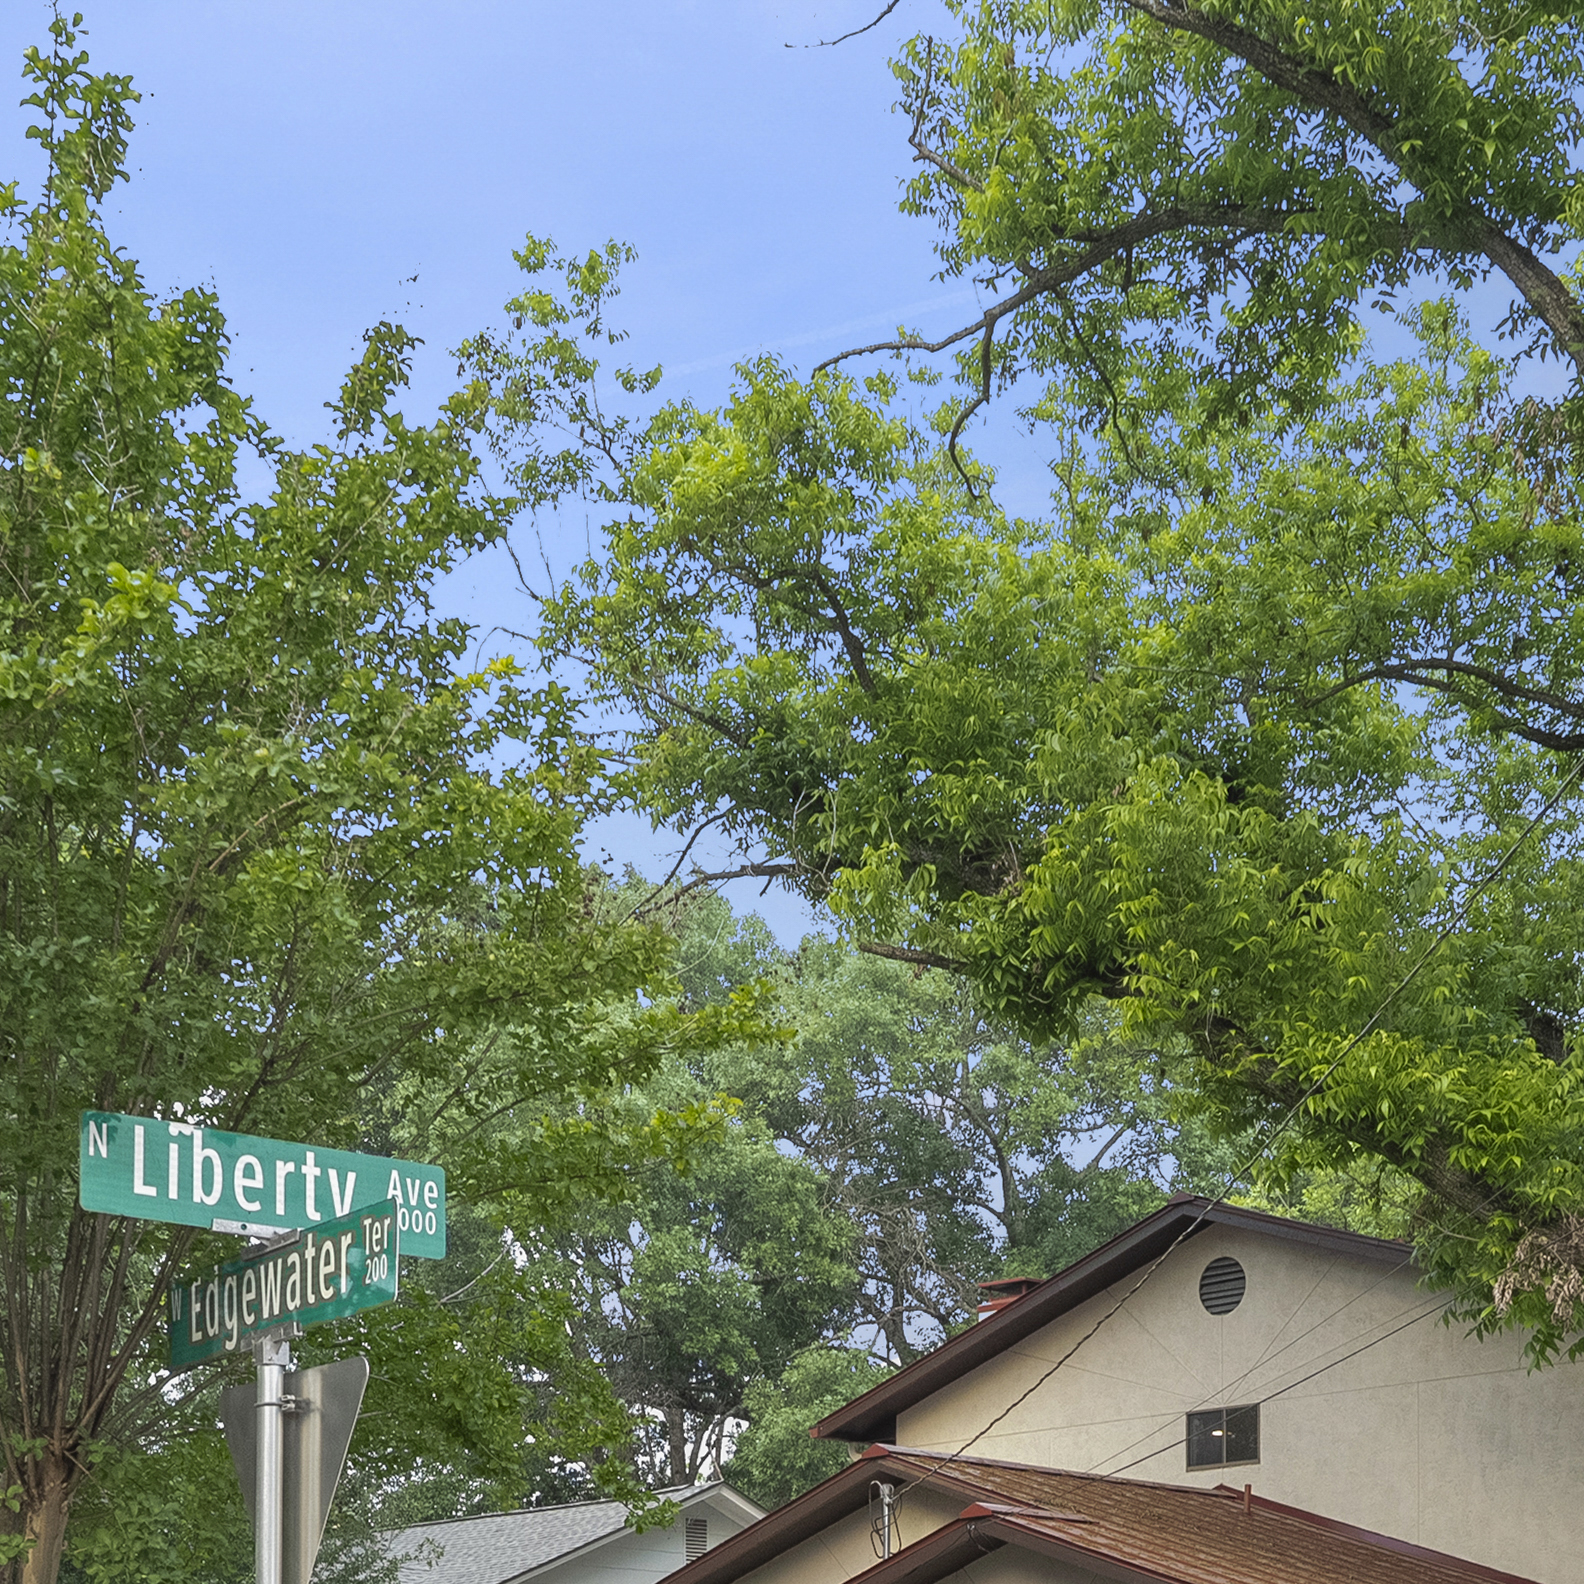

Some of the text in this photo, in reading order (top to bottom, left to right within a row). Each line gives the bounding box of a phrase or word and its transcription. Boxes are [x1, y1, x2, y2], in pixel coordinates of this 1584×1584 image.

[88, 1119, 439, 1222] N Liberty Ave
[171, 1216, 391, 1351] W Edgewater Ter
[364, 1256, 388, 1285] 200
